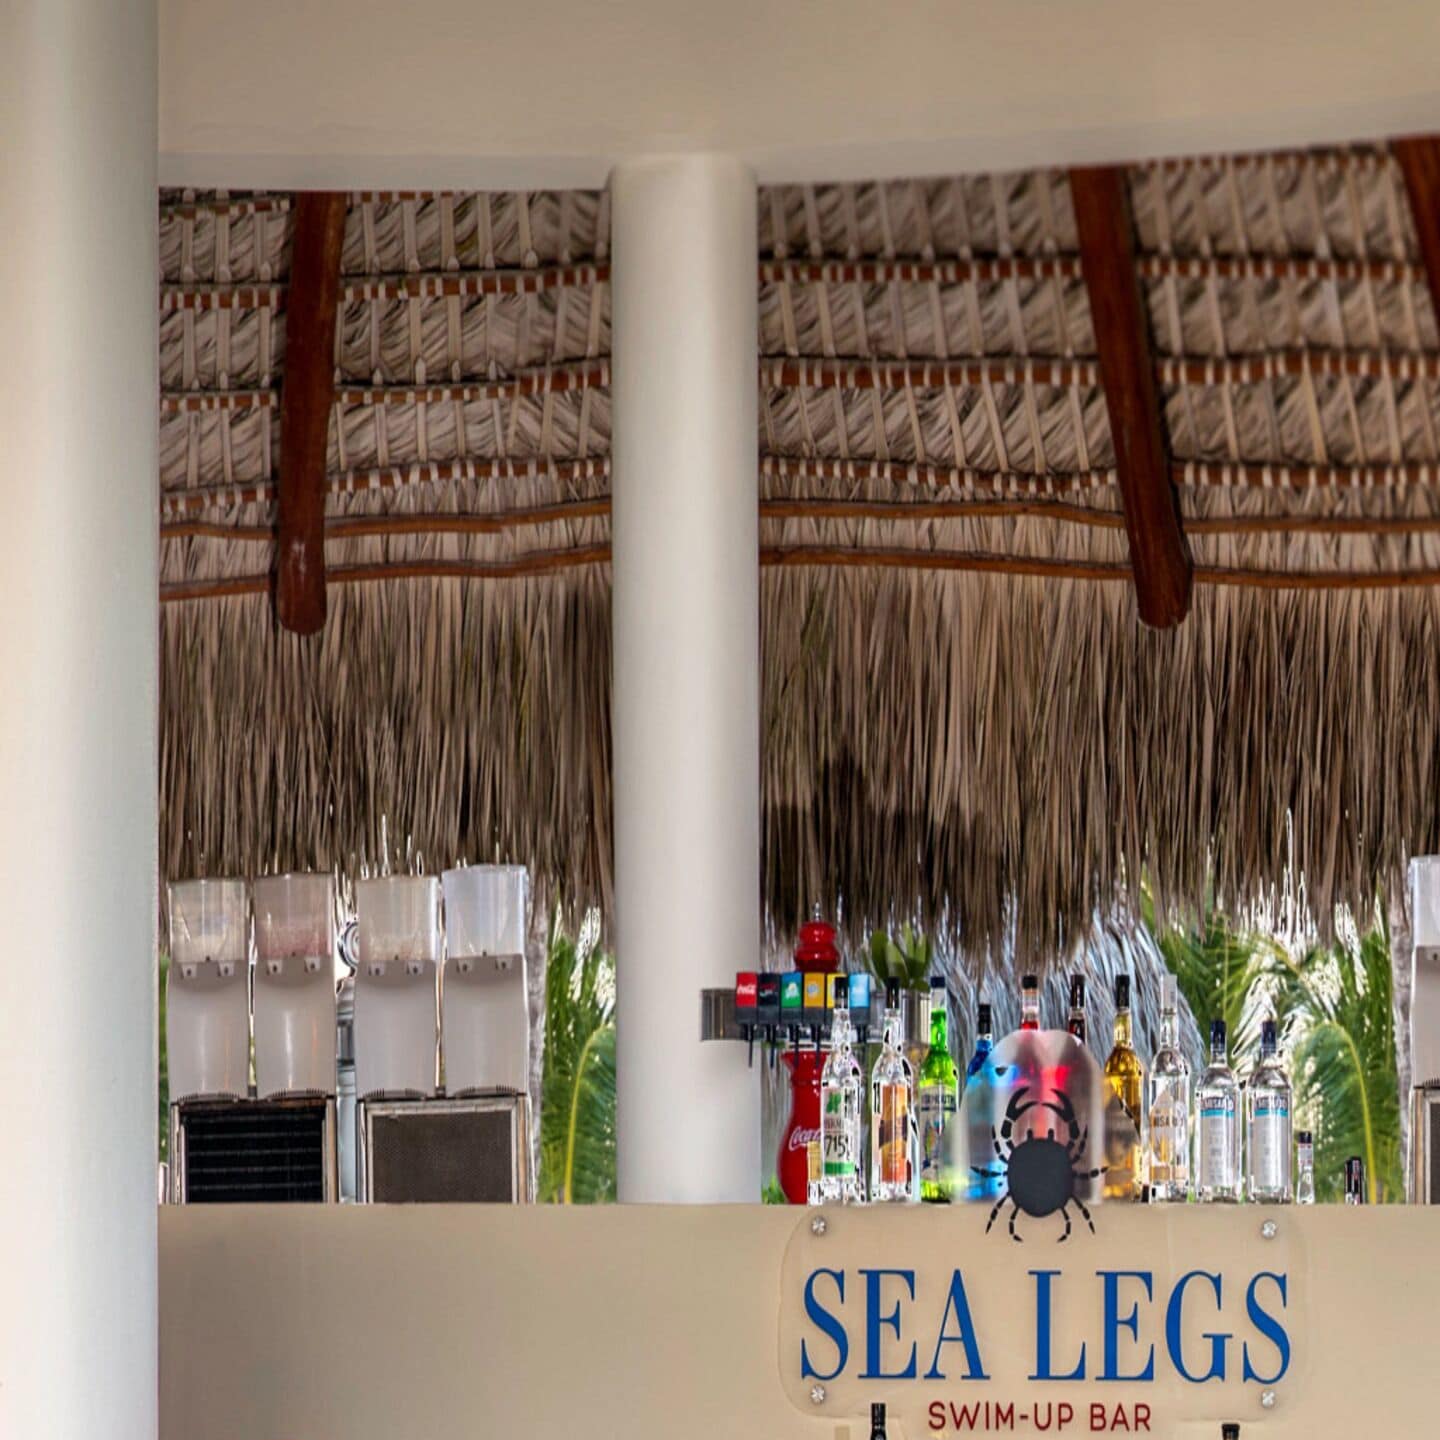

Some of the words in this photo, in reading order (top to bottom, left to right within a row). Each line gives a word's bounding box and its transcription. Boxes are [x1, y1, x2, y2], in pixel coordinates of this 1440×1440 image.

[801, 1268, 990, 1380] SEA
[1027, 1270, 1291, 1384] LEGS
[928, 1401, 1073, 1431] SWIM-UP
[1090, 1403, 1152, 1431] BAR
